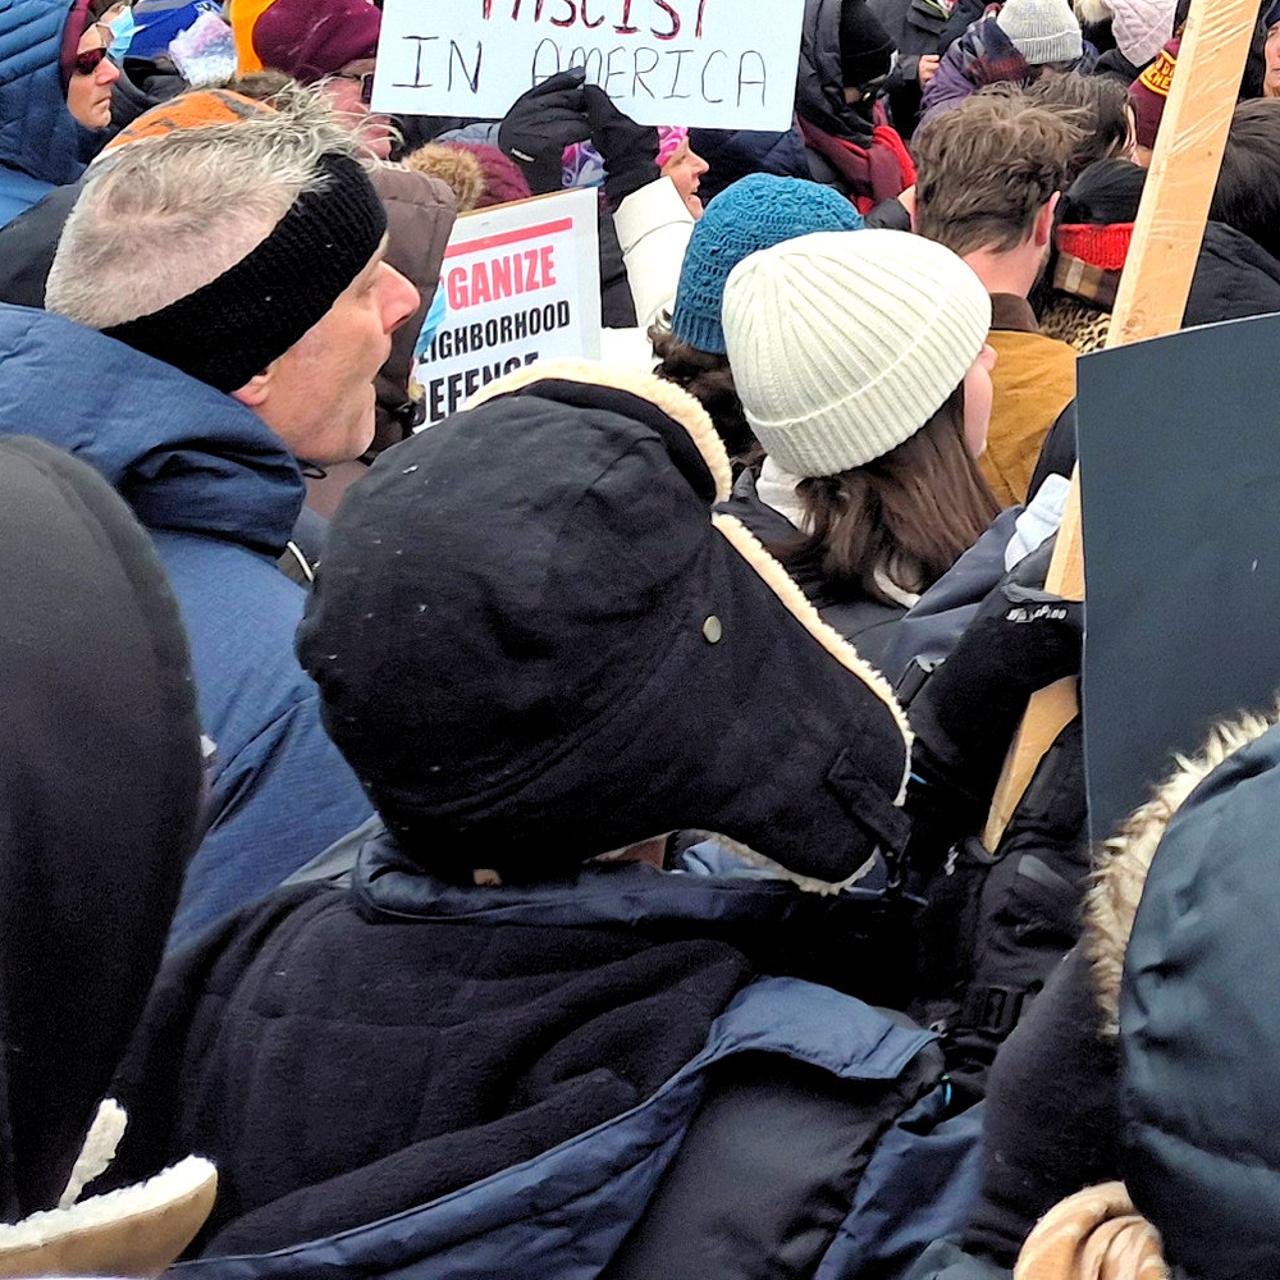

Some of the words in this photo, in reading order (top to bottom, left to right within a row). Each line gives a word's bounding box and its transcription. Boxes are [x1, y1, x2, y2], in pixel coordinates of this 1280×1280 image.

[392, 35, 483, 93] IN
[532, 37, 767, 107] AMERICA
[441, 245, 557, 311] GANIZE
